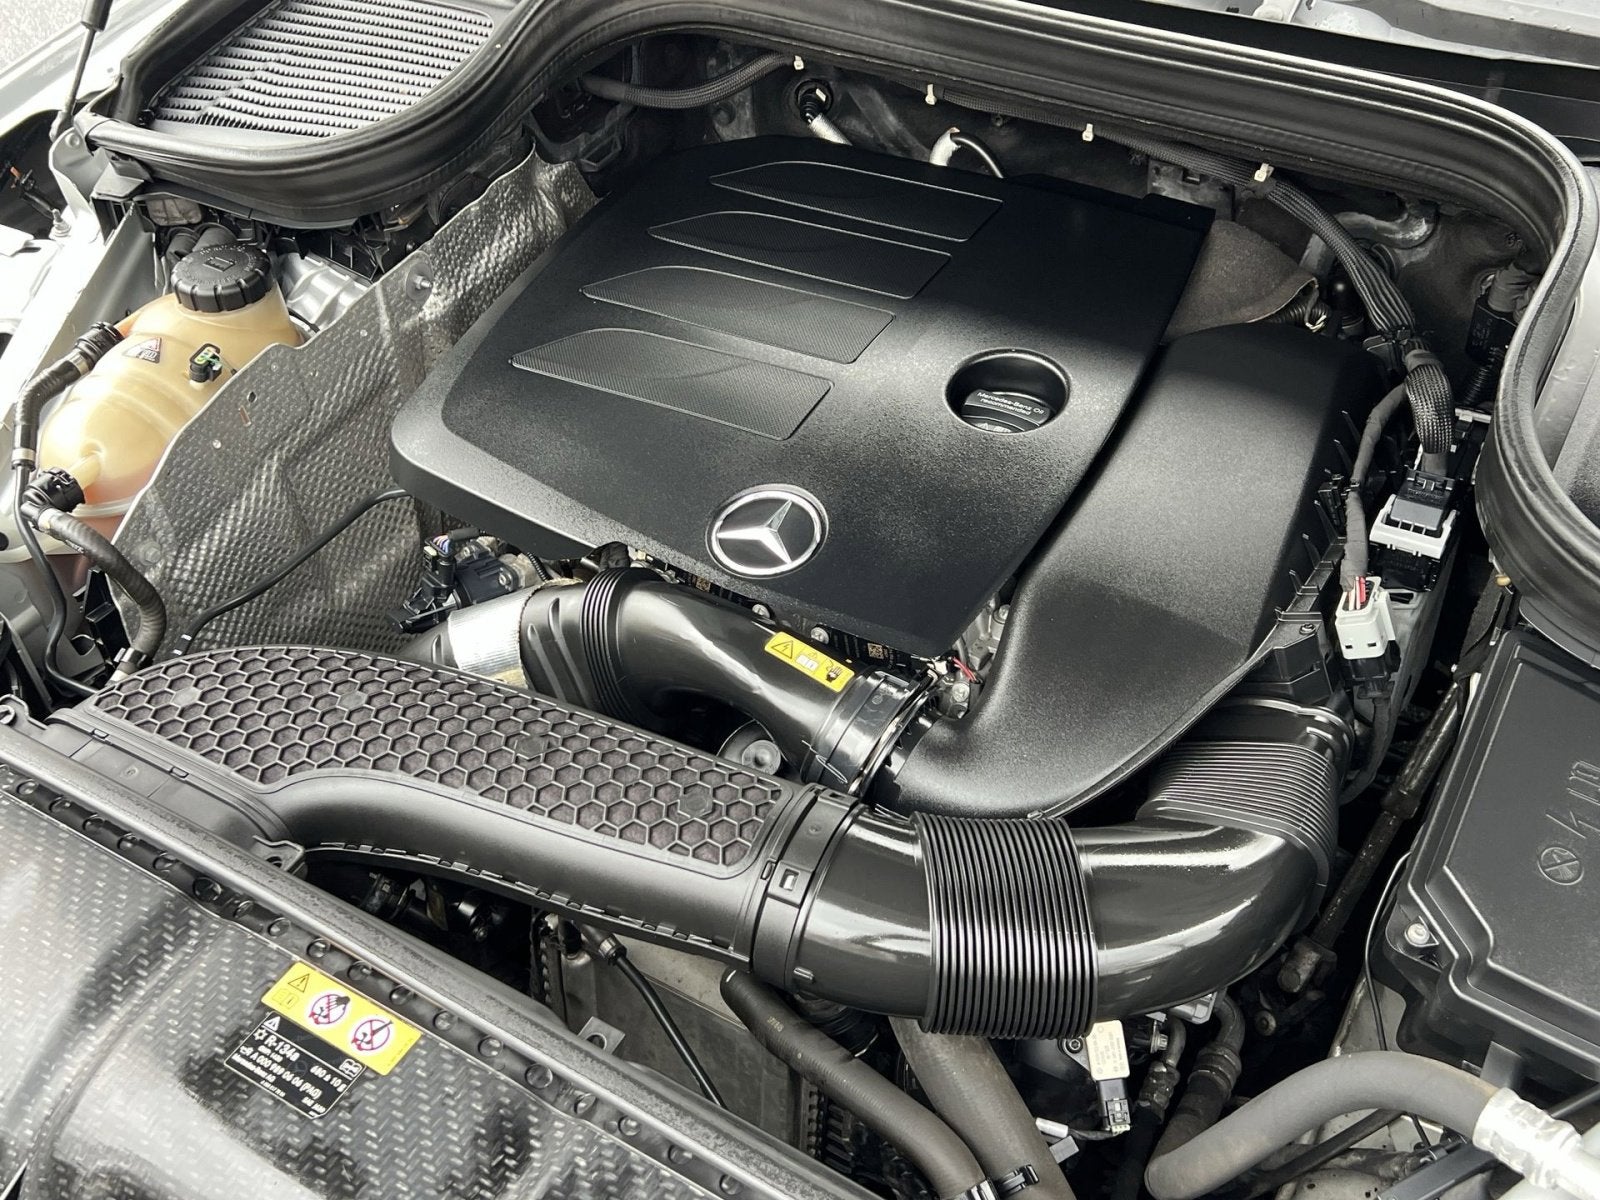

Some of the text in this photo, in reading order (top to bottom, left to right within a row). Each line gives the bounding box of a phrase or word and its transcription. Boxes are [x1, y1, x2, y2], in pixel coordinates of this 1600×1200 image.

[977, 392, 1032, 411] Mercedes-Benz
[980, 398, 1031, 415] recommended
[264, 1034, 300, 1062] R-134a
